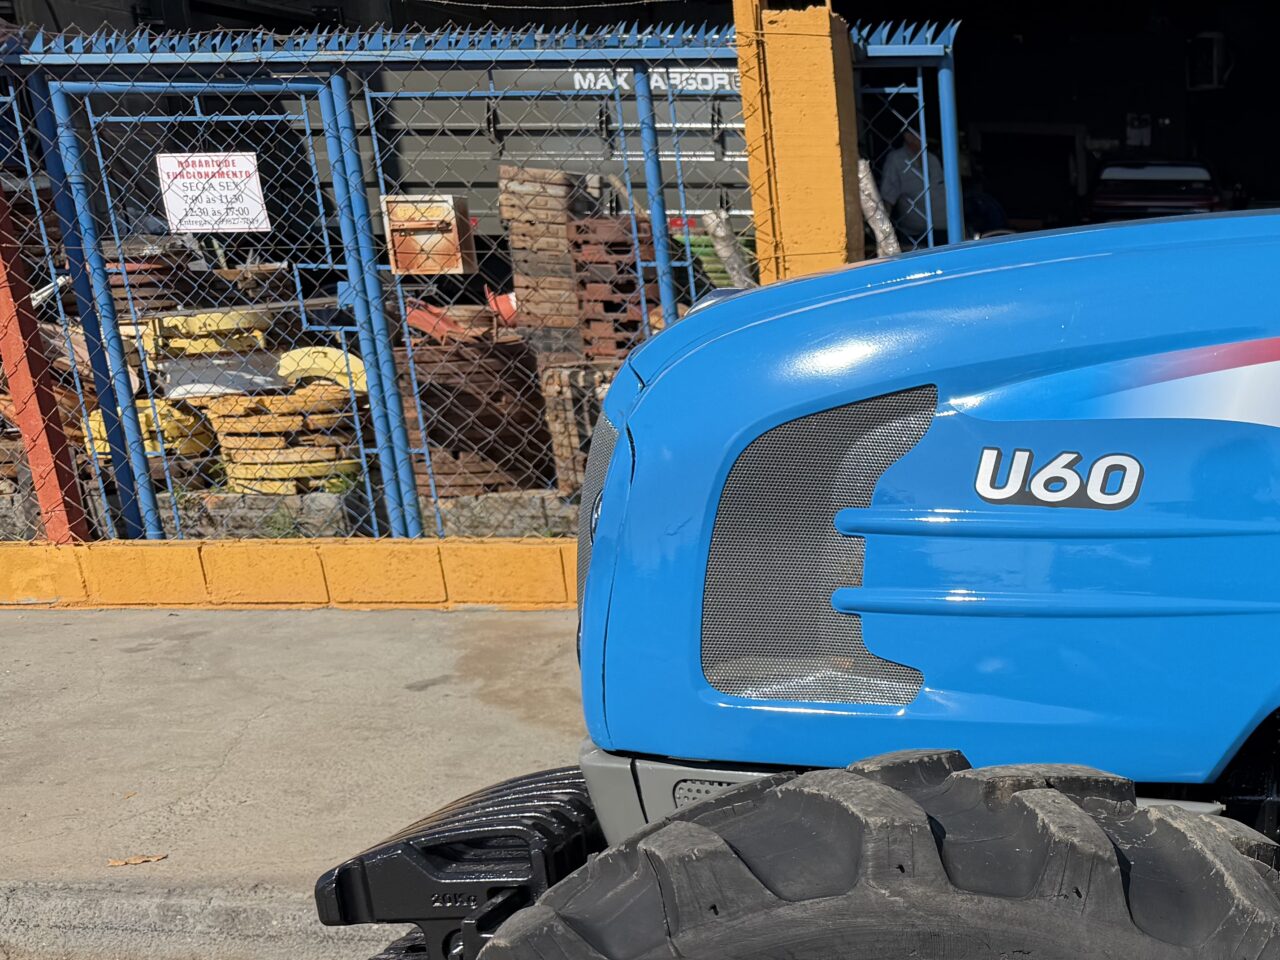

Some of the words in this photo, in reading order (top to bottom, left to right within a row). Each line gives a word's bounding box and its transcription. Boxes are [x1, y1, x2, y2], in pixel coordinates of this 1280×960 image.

[225, 159, 237, 168] DE
[167, 170, 251, 180] FUNCIONAMENTO
[974, 447, 1144, 510] U60
